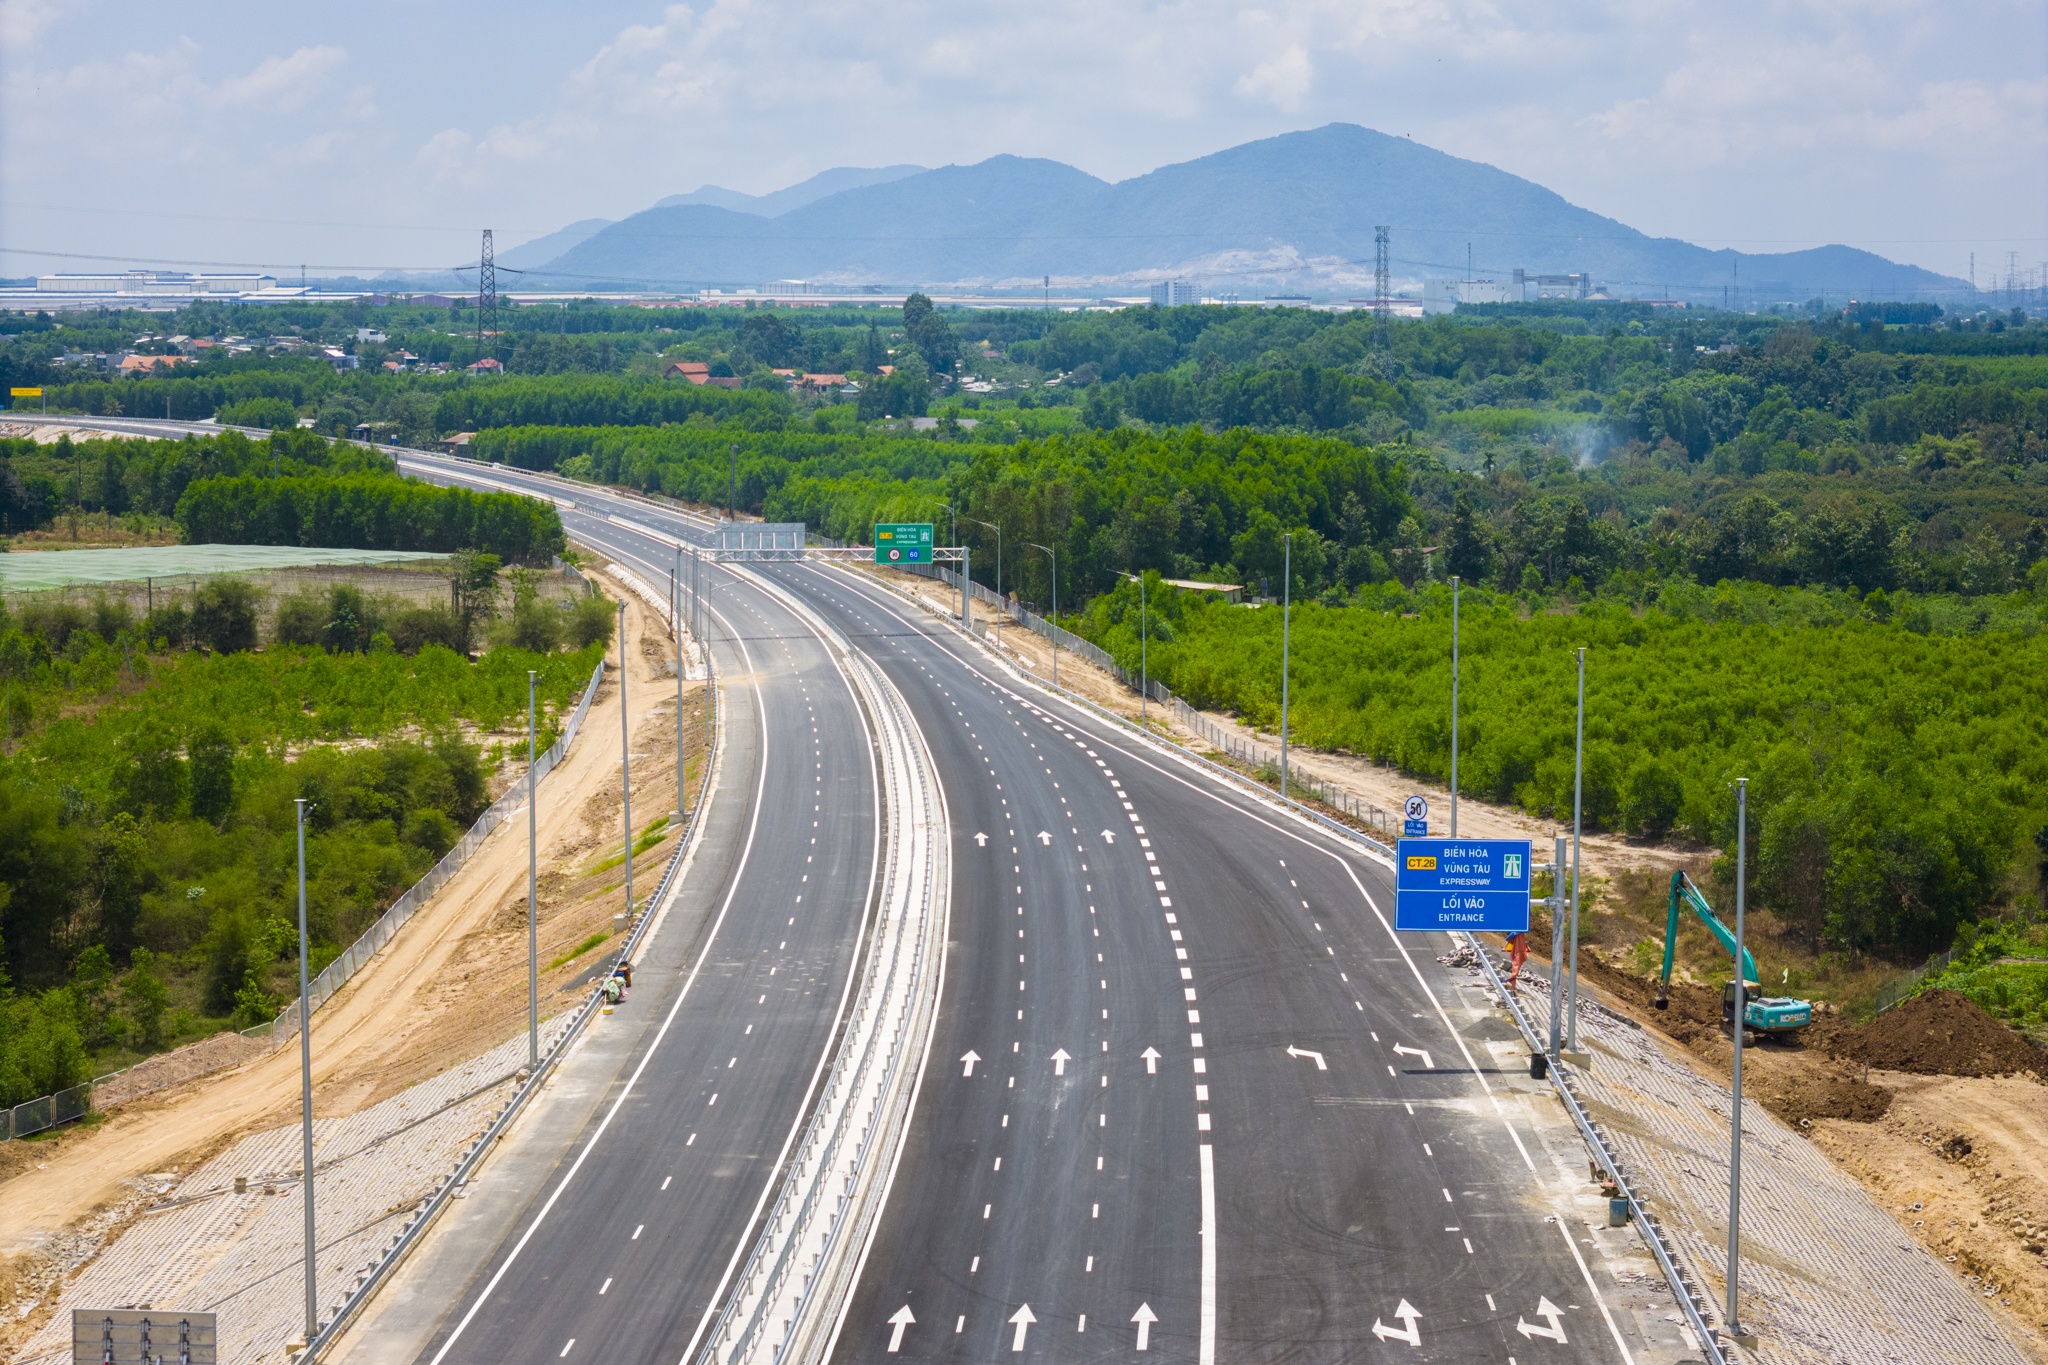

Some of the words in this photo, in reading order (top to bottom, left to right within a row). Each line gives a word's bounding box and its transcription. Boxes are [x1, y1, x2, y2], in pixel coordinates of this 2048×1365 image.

[1410, 802, 1422, 816] 50
[1444, 846, 1466, 858] BIÊN
[1468, 846, 1488, 858] HÒA
[1408, 858, 1435, 868] CT.28
[1444, 862, 1470, 874] VŨNG
[1472, 862, 1490, 874] TÀU
[1440, 878, 1490, 886] EXPRESSWAY
[1442, 892, 1460, 908] LỐI
[1464, 896, 1484, 908] VÀO
[1438, 914, 1484, 922] ENTRANCE
